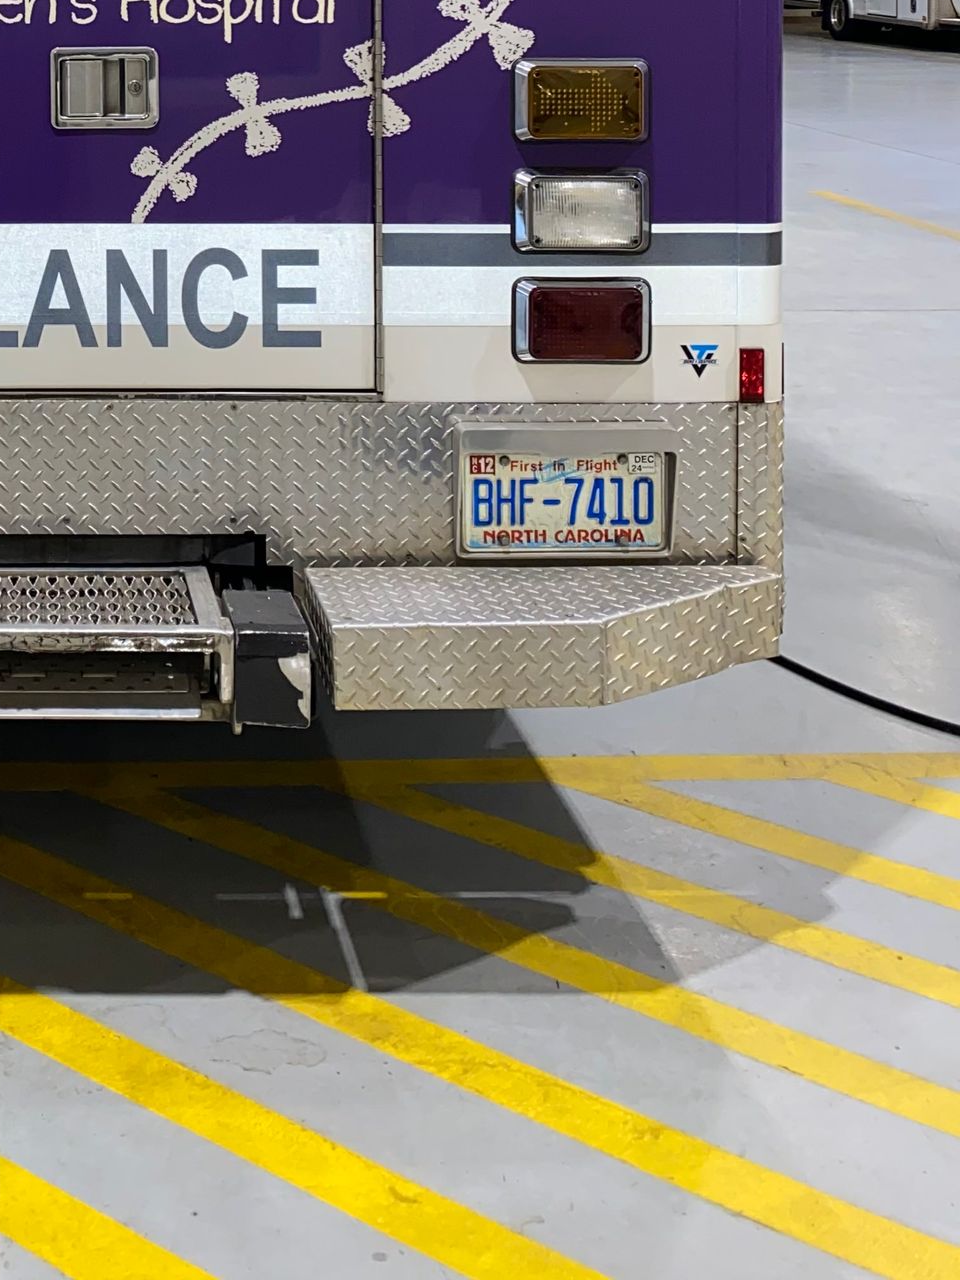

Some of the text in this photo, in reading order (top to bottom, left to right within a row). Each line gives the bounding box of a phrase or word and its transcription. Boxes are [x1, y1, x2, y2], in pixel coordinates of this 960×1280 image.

[478, 457, 495, 473] 12
[510, 459, 618, 473] First in Flight
[634, 455, 654, 464] DEC
[631, 464, 642, 472] 24
[473, 477, 655, 527] BHF-7410
[483, 528, 646, 544] NORTH CAROLINA
